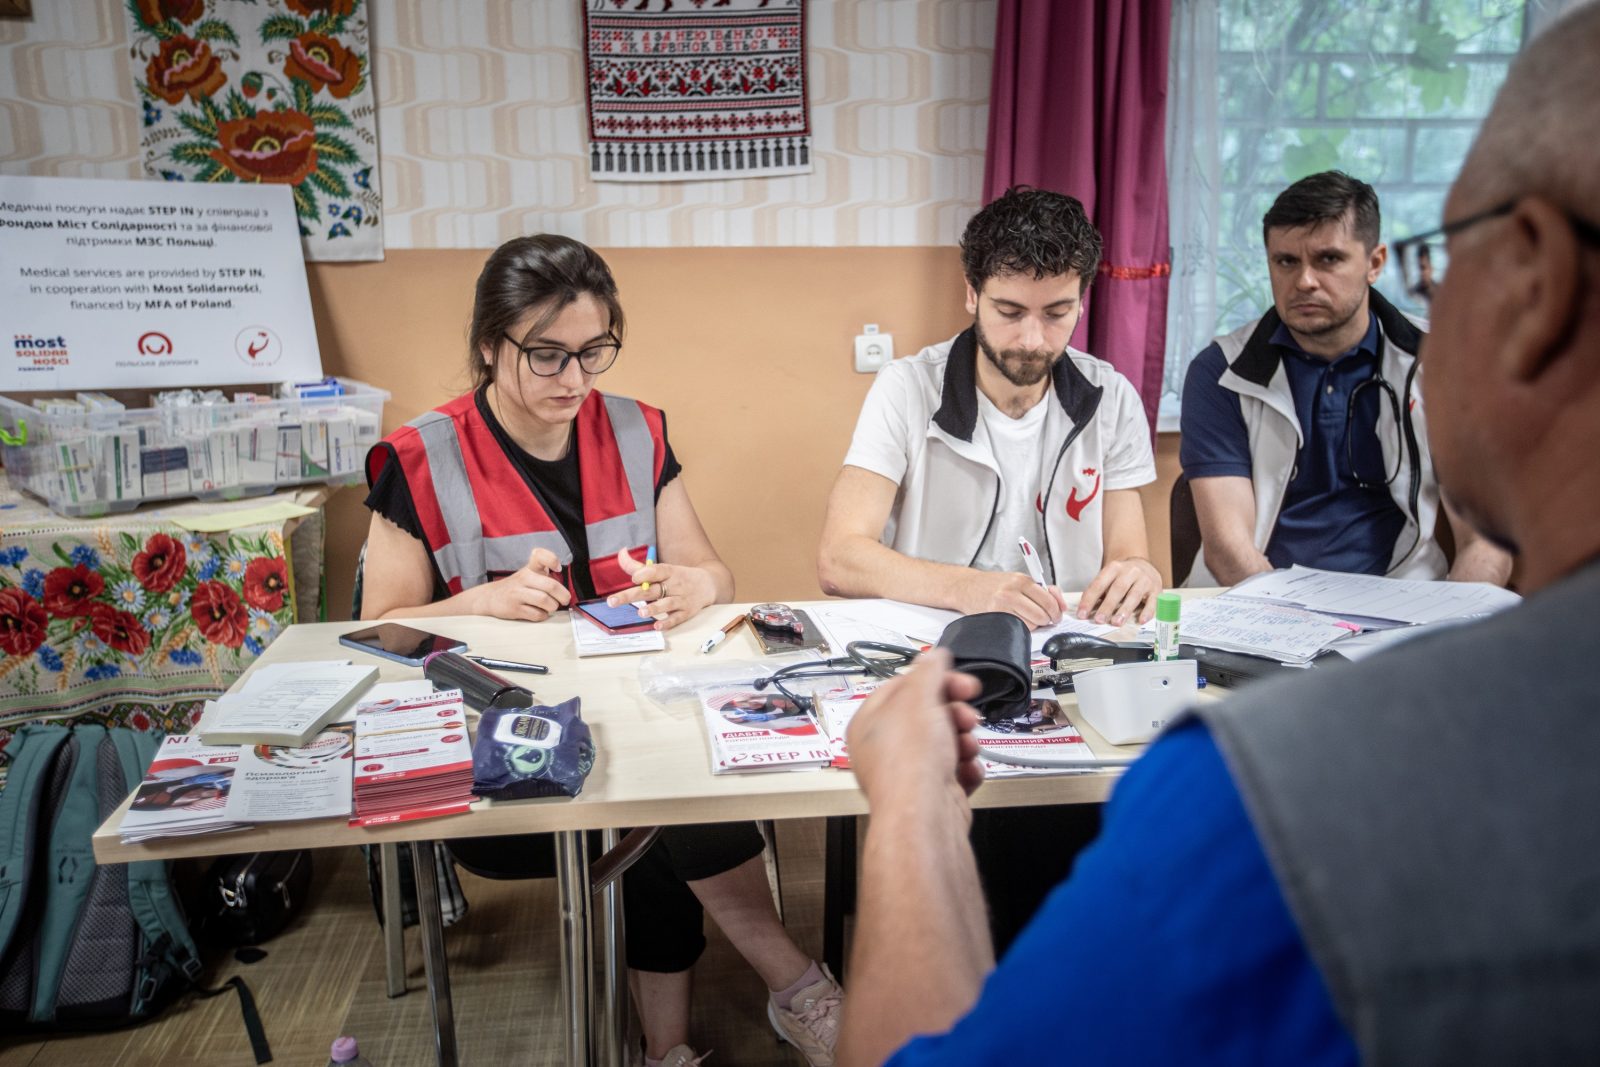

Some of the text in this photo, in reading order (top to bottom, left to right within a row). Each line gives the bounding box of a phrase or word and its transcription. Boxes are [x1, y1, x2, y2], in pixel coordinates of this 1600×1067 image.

[55, 204, 106, 216] послуги
[110, 205, 145, 215] надає
[148, 206, 177, 216] STEP
[180, 206, 194, 216] IN
[197, 208, 203, 218] у
[206, 207, 260, 219] співпраці
[263, 209, 269, 217] з
[57, 219, 88, 229] Міст
[91, 219, 177, 232] Солідарності
[196, 224, 208, 232] за
[211, 222, 273, 233] фінансової
[66, 235, 133, 248] підтримки
[135, 237, 163, 247] МЗС
[20, 266, 70, 278] Medical
[73, 267, 122, 278] services
[125, 270, 145, 278] are
[148, 267, 200, 280] provided
[203, 268, 216, 281] by
[218, 268, 246, 279] STEP
[30, 284, 42, 294] in
[45, 284, 121, 296] cooperation
[124, 283, 150, 294] with
[153, 284, 184, 294] Most
[70, 299, 124, 311] financed
[127, 300, 142, 313] by
[144, 300, 172, 310] MFA
[175, 299, 188, 310] of
[14, 335, 67, 349] most
[16, 350, 68, 358] SOLIDAR
[415, 694, 443, 702] STEP
[751, 749, 830, 763] STEP IN
